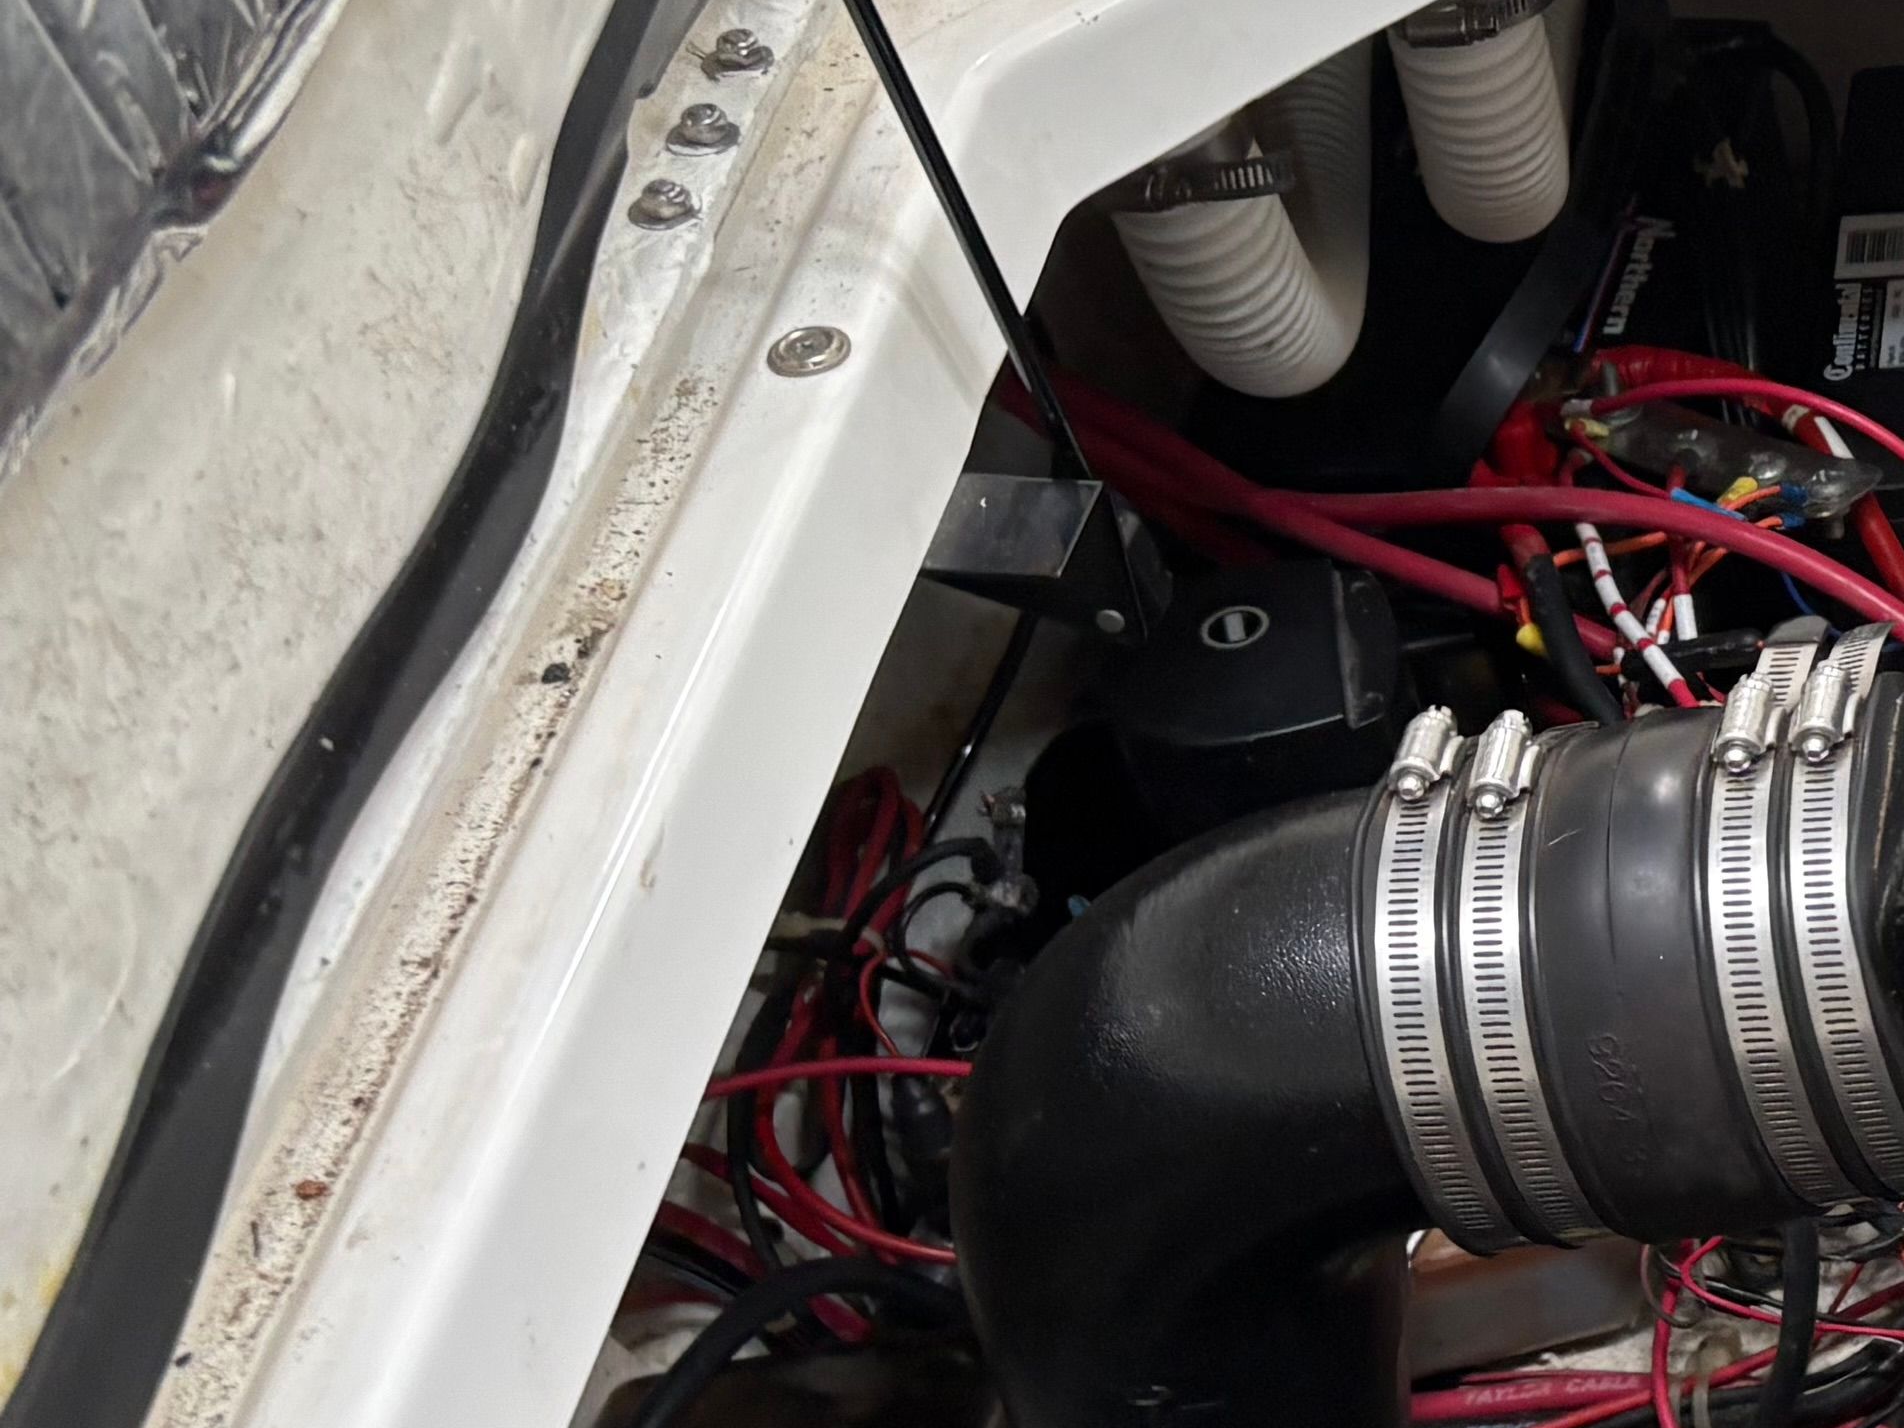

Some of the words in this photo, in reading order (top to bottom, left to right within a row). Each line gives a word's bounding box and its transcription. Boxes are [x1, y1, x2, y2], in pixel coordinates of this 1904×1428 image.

[1604, 216, 1677, 335] Northern
[1461, 1380, 1552, 1409] TAYLOR
[1565, 1373, 1644, 1396] CABLE
